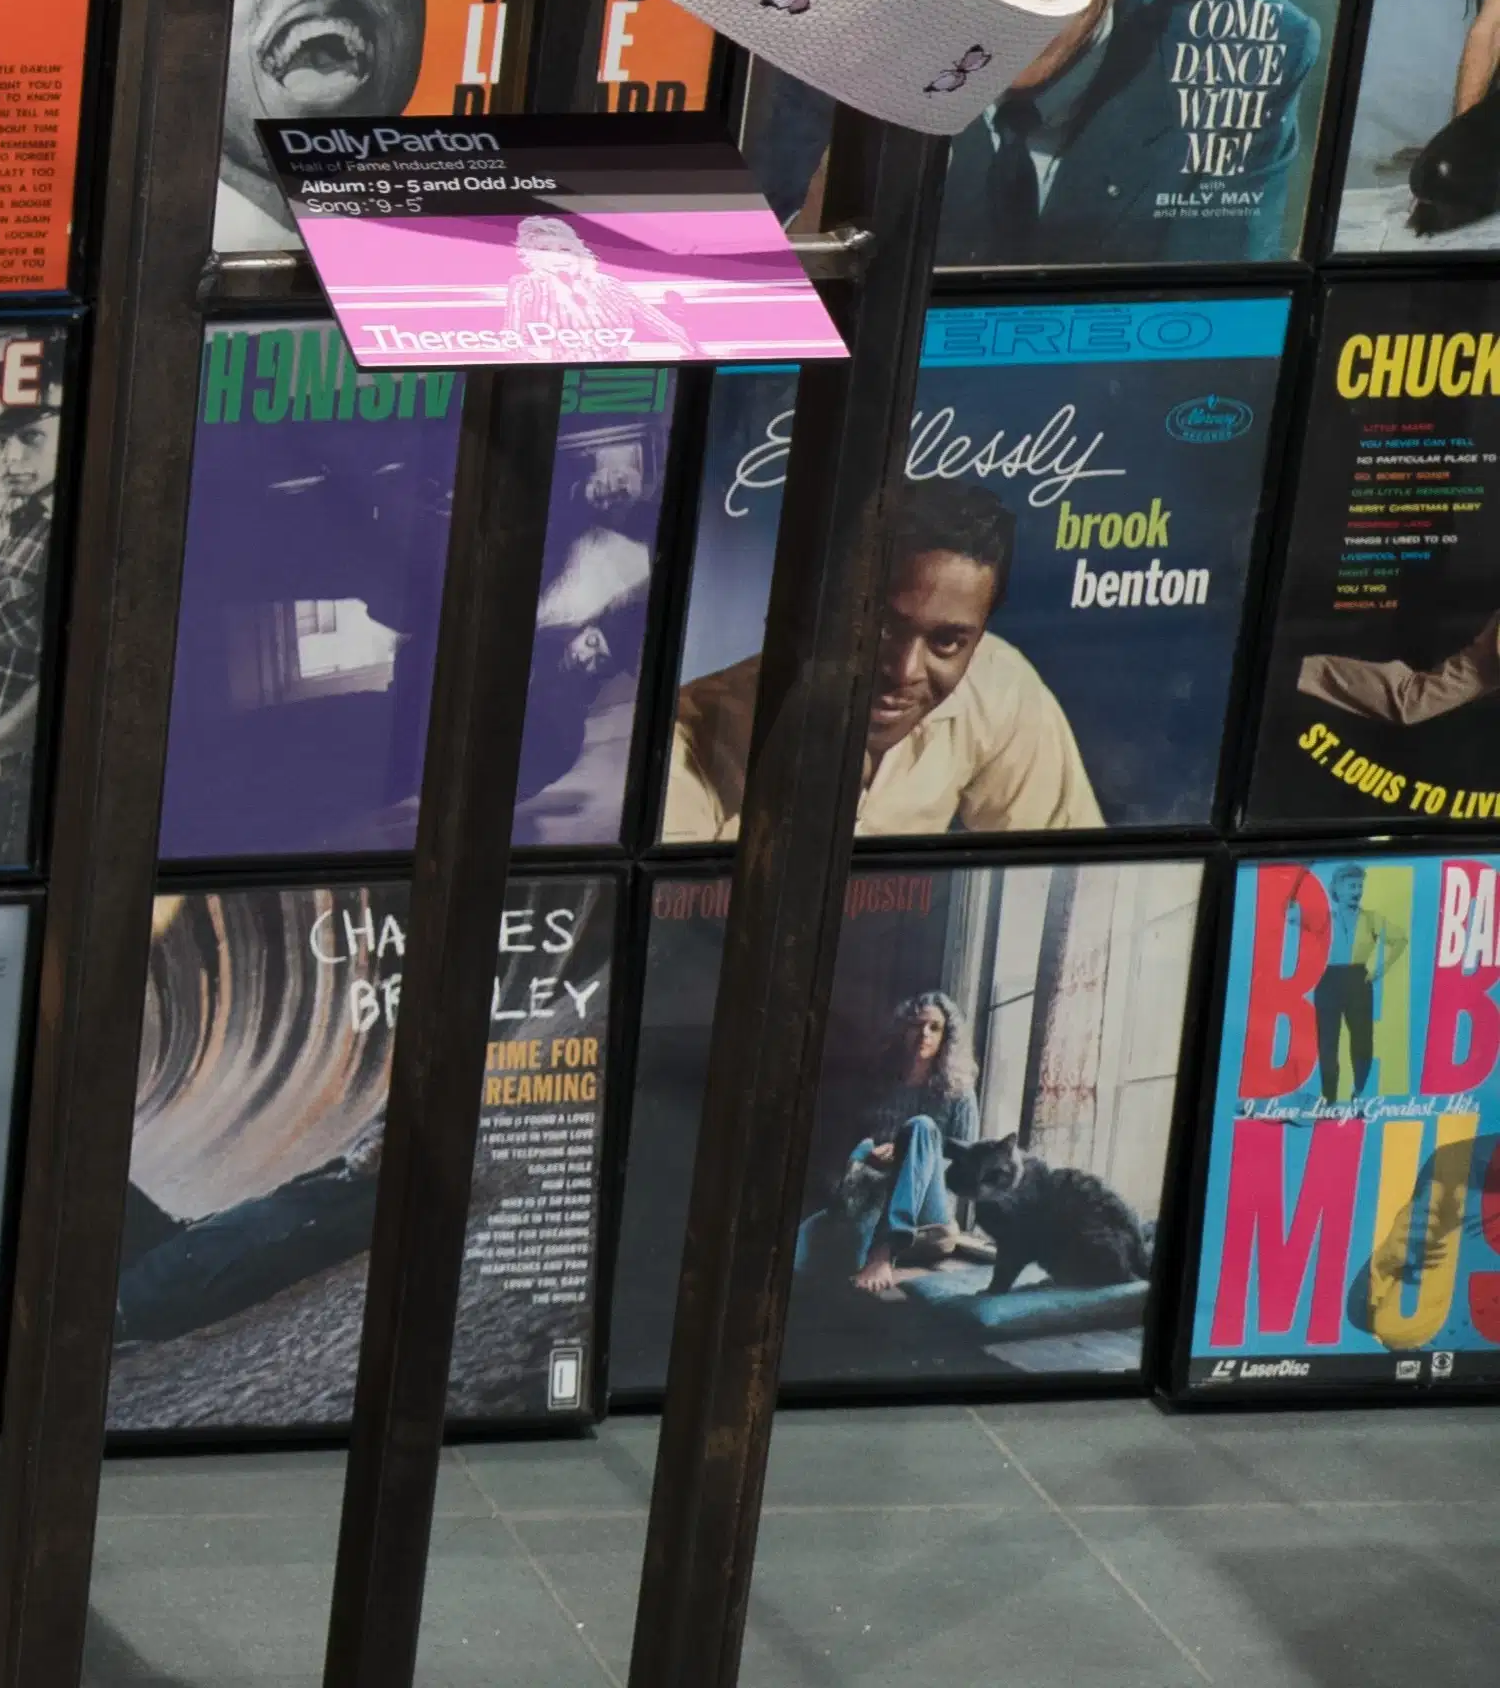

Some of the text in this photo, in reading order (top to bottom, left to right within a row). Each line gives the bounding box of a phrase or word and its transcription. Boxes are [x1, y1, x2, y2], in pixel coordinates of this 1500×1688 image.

[1170, 42, 1287, 87] DANCE
[1176, 87, 1272, 131] WITH
[279, 126, 501, 160] Dolly Parton
[1180, 132, 1253, 177] ME!
[1155, 190, 1265, 207] BILLY MAY
[361, 321, 641, 352] Theresa Perez
[1336, 332, 1500, 400] CHUCK
[1055, 497, 1173, 552] brook
[1070, 558, 1211, 609] benton
[1239, 1359, 1309, 1379] LaserDisc
